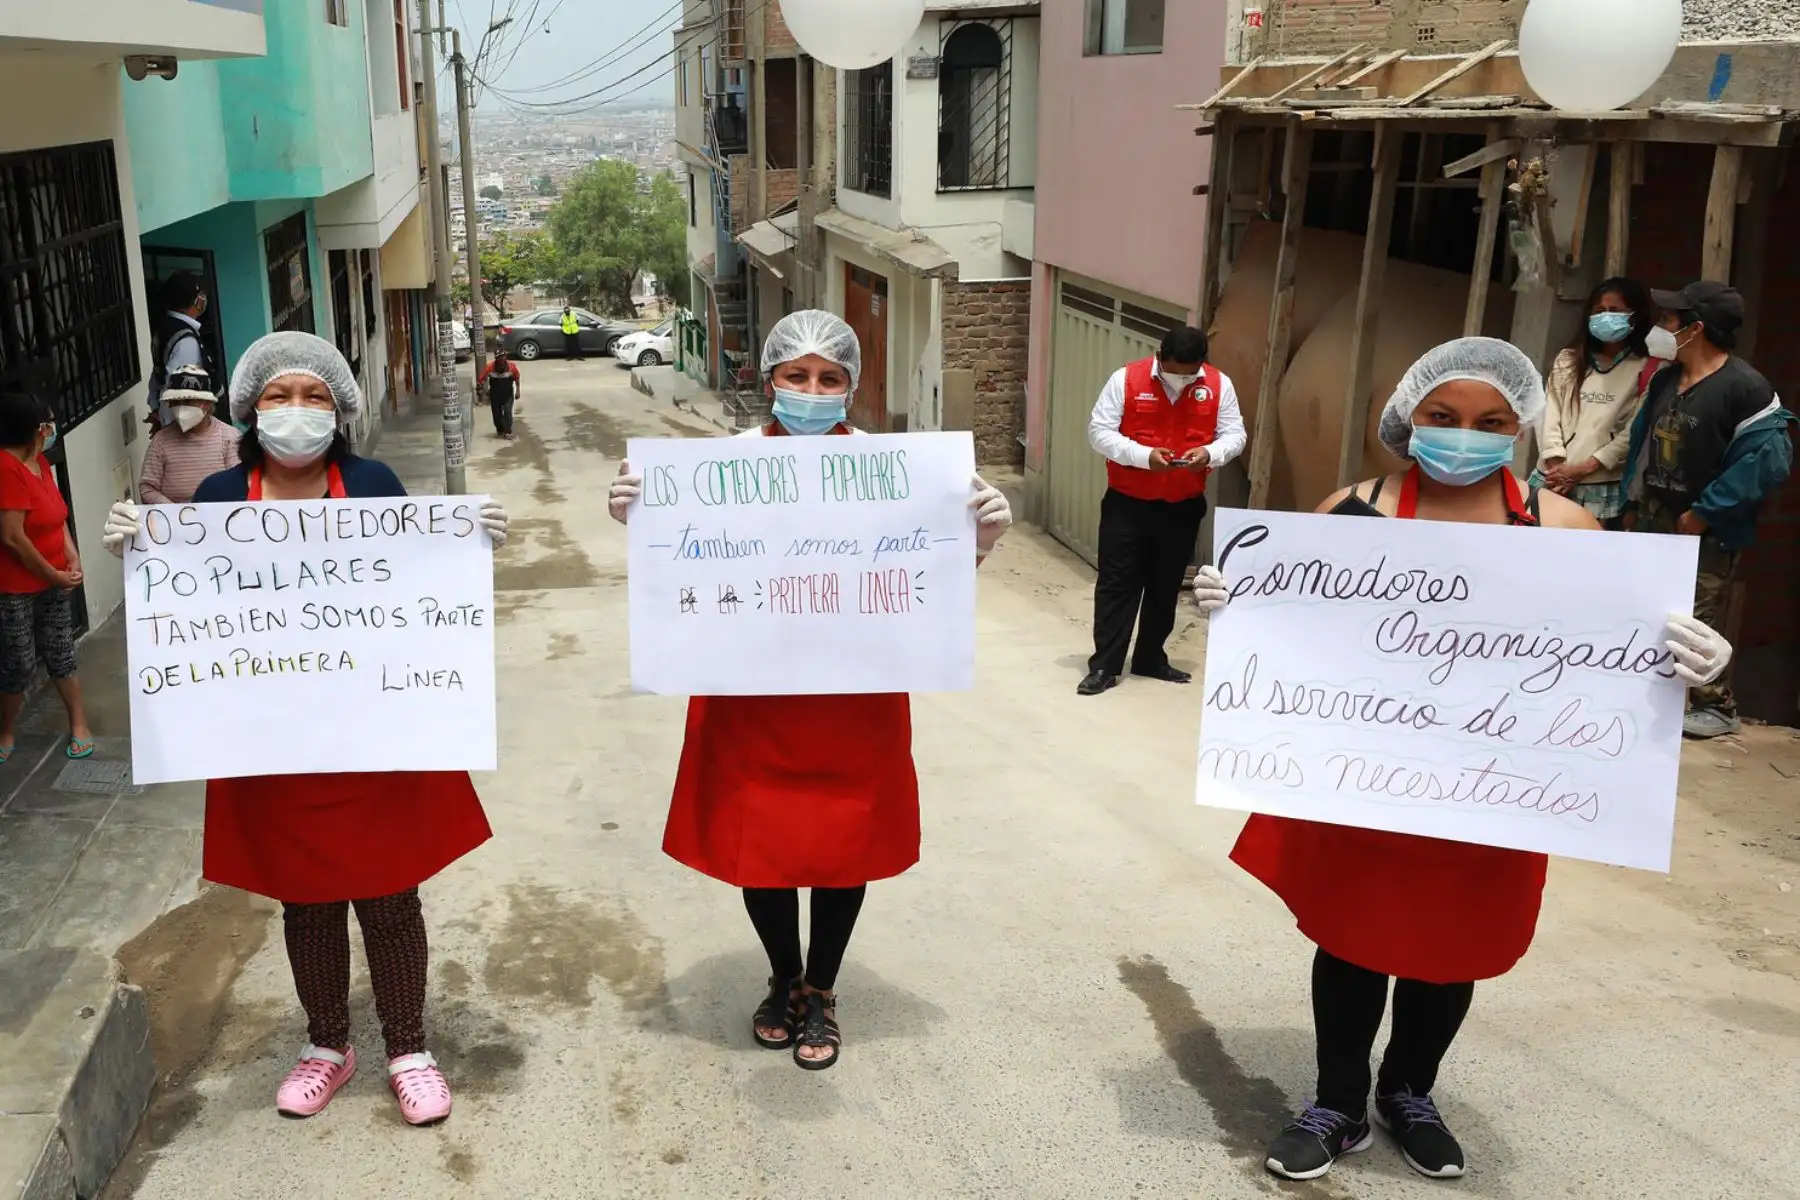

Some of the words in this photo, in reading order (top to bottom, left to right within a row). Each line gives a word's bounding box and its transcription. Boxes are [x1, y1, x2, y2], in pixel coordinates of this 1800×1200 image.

[644, 465, 679, 507] LOS
[693, 454, 799, 506] COMEDORES
[821, 449, 910, 502] POPULARES
[225, 503, 475, 544] COMEDORES
[673, 523, 766, 561] tambien
[785, 537, 863, 557] somos
[873, 526, 930, 563] parte
[136, 555, 392, 603] POPULARES
[769, 573, 841, 615] PRIMERA
[859, 568, 911, 615] LINEA
[1218, 525, 1470, 606] Comedores
[301, 602, 408, 631] SOMOS
[418, 597, 485, 628] PARTE
[1376, 611, 1678, 694] Organizados
[1207, 653, 1258, 711] al
[1263, 680, 1450, 730] servicio
[1459, 692, 1517, 743] de
[1533, 698, 1624, 757] los
[1199, 742, 1304, 788] más
[1325, 754, 1600, 823] necesitados
